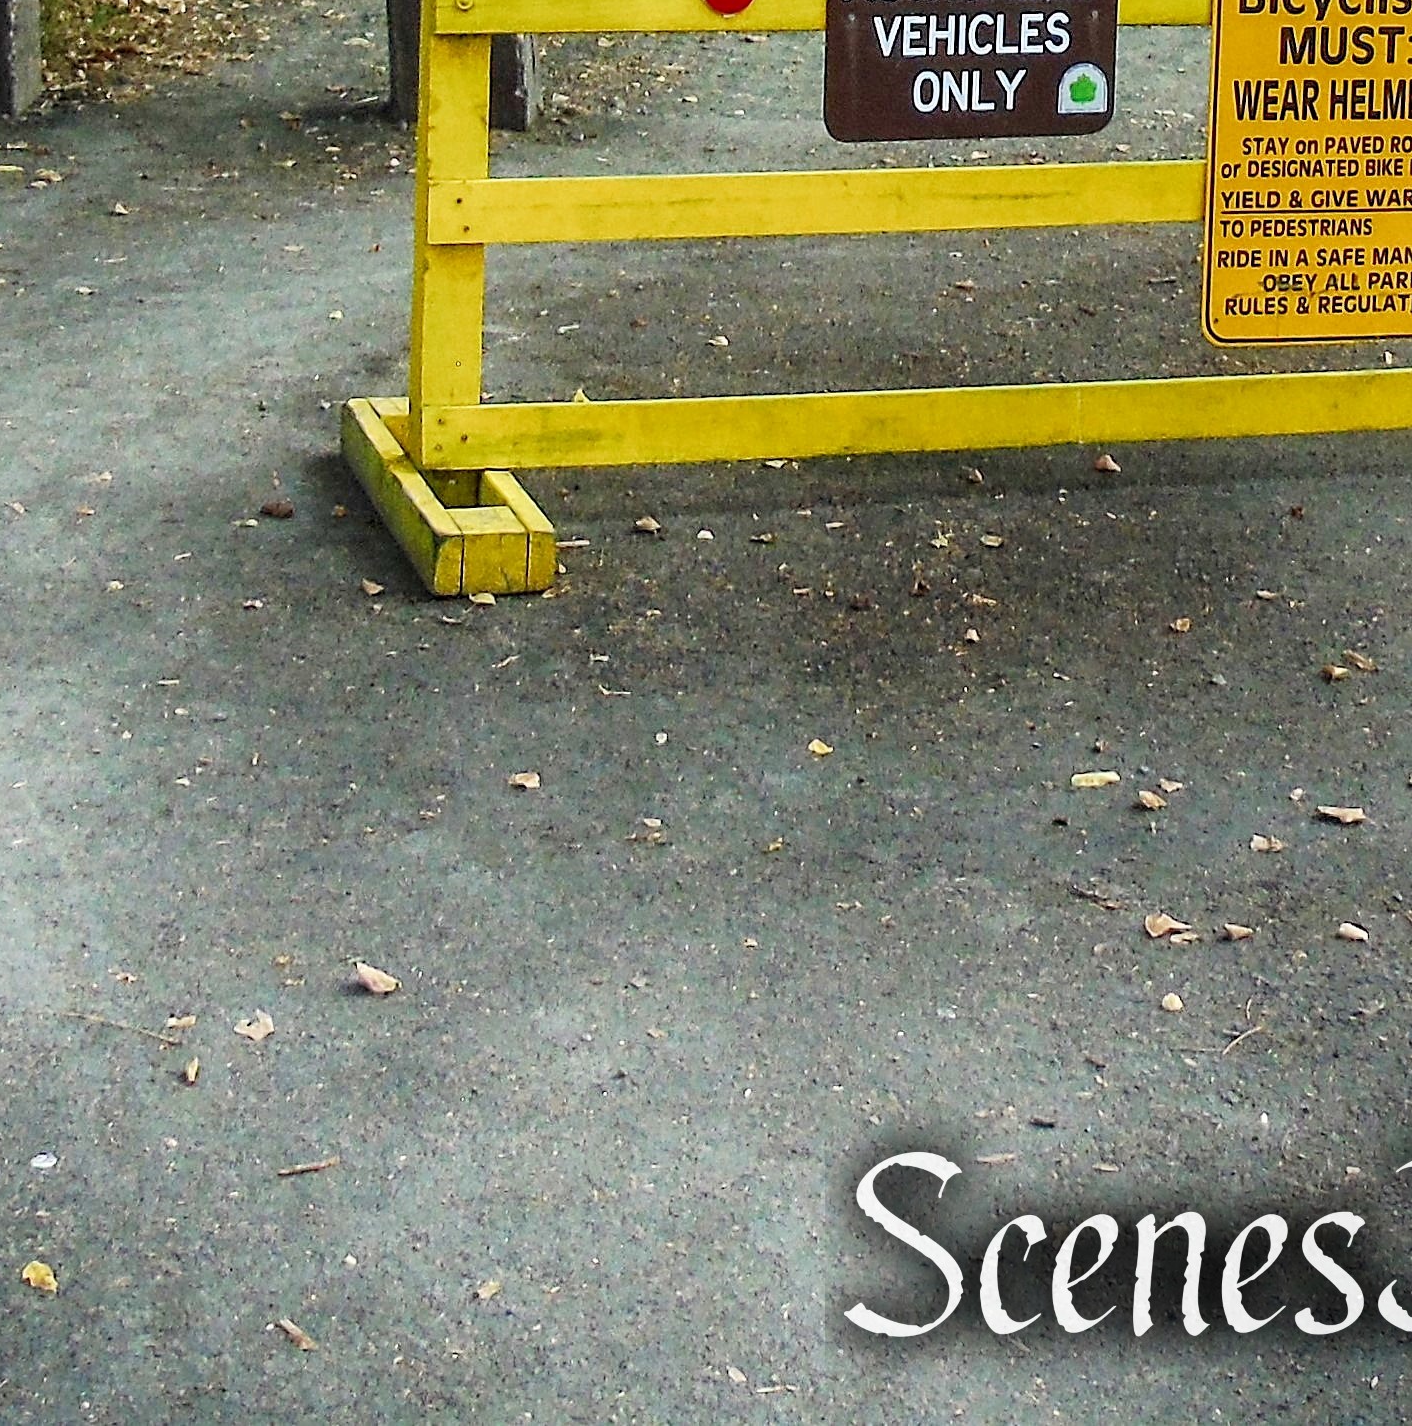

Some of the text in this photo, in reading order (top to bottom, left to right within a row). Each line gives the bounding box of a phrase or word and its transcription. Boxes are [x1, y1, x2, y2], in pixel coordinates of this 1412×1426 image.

[874, 13, 1070, 56] VEHICLES
[913, 70, 1027, 113] ONLY
[1234, 80, 1319, 120] WEAR
[1242, 137, 1289, 154] STAY
[1295, 139, 1318, 154] on
[1325, 137, 1384, 154] PAVED
[1221, 162, 1240, 178] or
[1248, 160, 1359, 178] DESIGNATED
[1365, 159, 1404, 176] BIKE
[1221, 191, 1280, 208] YIELD
[1289, 191, 1303, 207] &
[1311, 190, 1358, 207] GIVE
[1220, 219, 1373, 237] TO PEDESTRIANS
[1218, 250, 1261, 268] RIDE
[1269, 250, 1289, 267] IN
[1295, 250, 1309, 266] A
[1317, 248, 1364, 266] SAFE
[1263, 274, 1317, 292] OBEY
[1326, 273, 1360, 290] ALL
[1225, 296, 1288, 315] RULES
[1296, 296, 1310, 314] &
